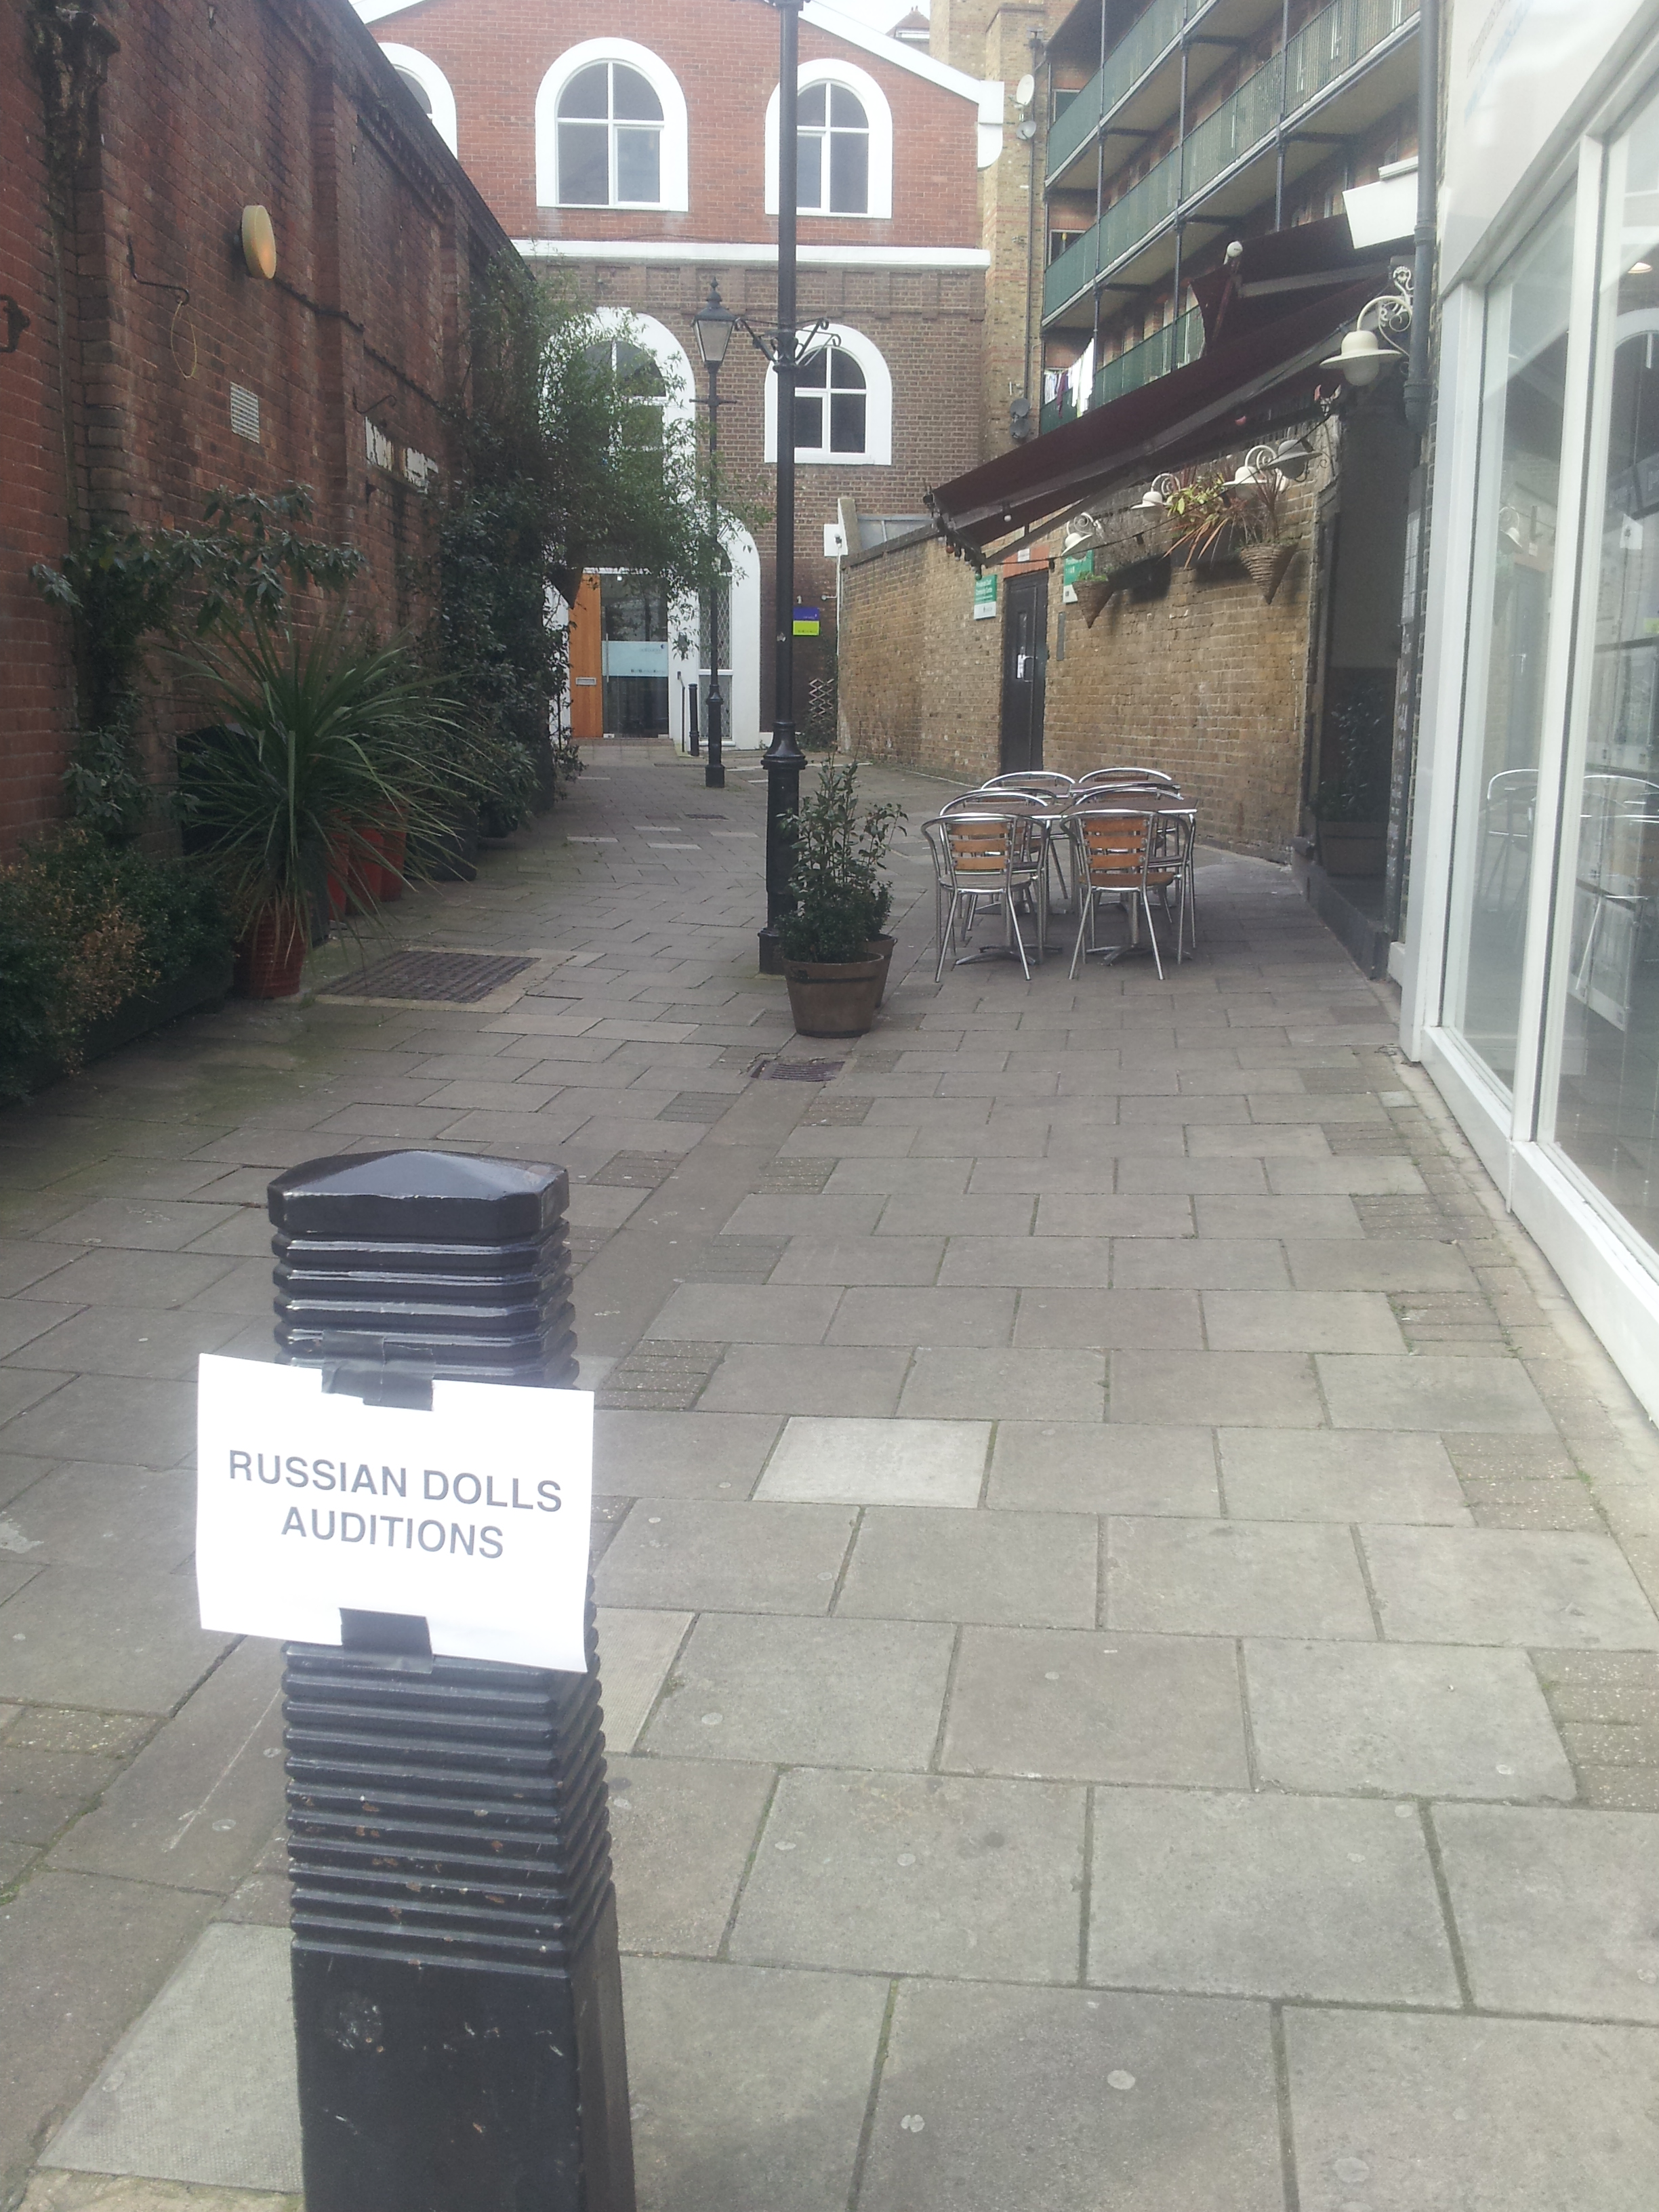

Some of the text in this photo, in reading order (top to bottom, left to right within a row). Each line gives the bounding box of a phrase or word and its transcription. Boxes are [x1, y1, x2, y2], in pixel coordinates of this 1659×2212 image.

[229, 1449, 562, 1513] RUSSIAN DOLLS
[281, 1506, 504, 1559] AUDITIONS
